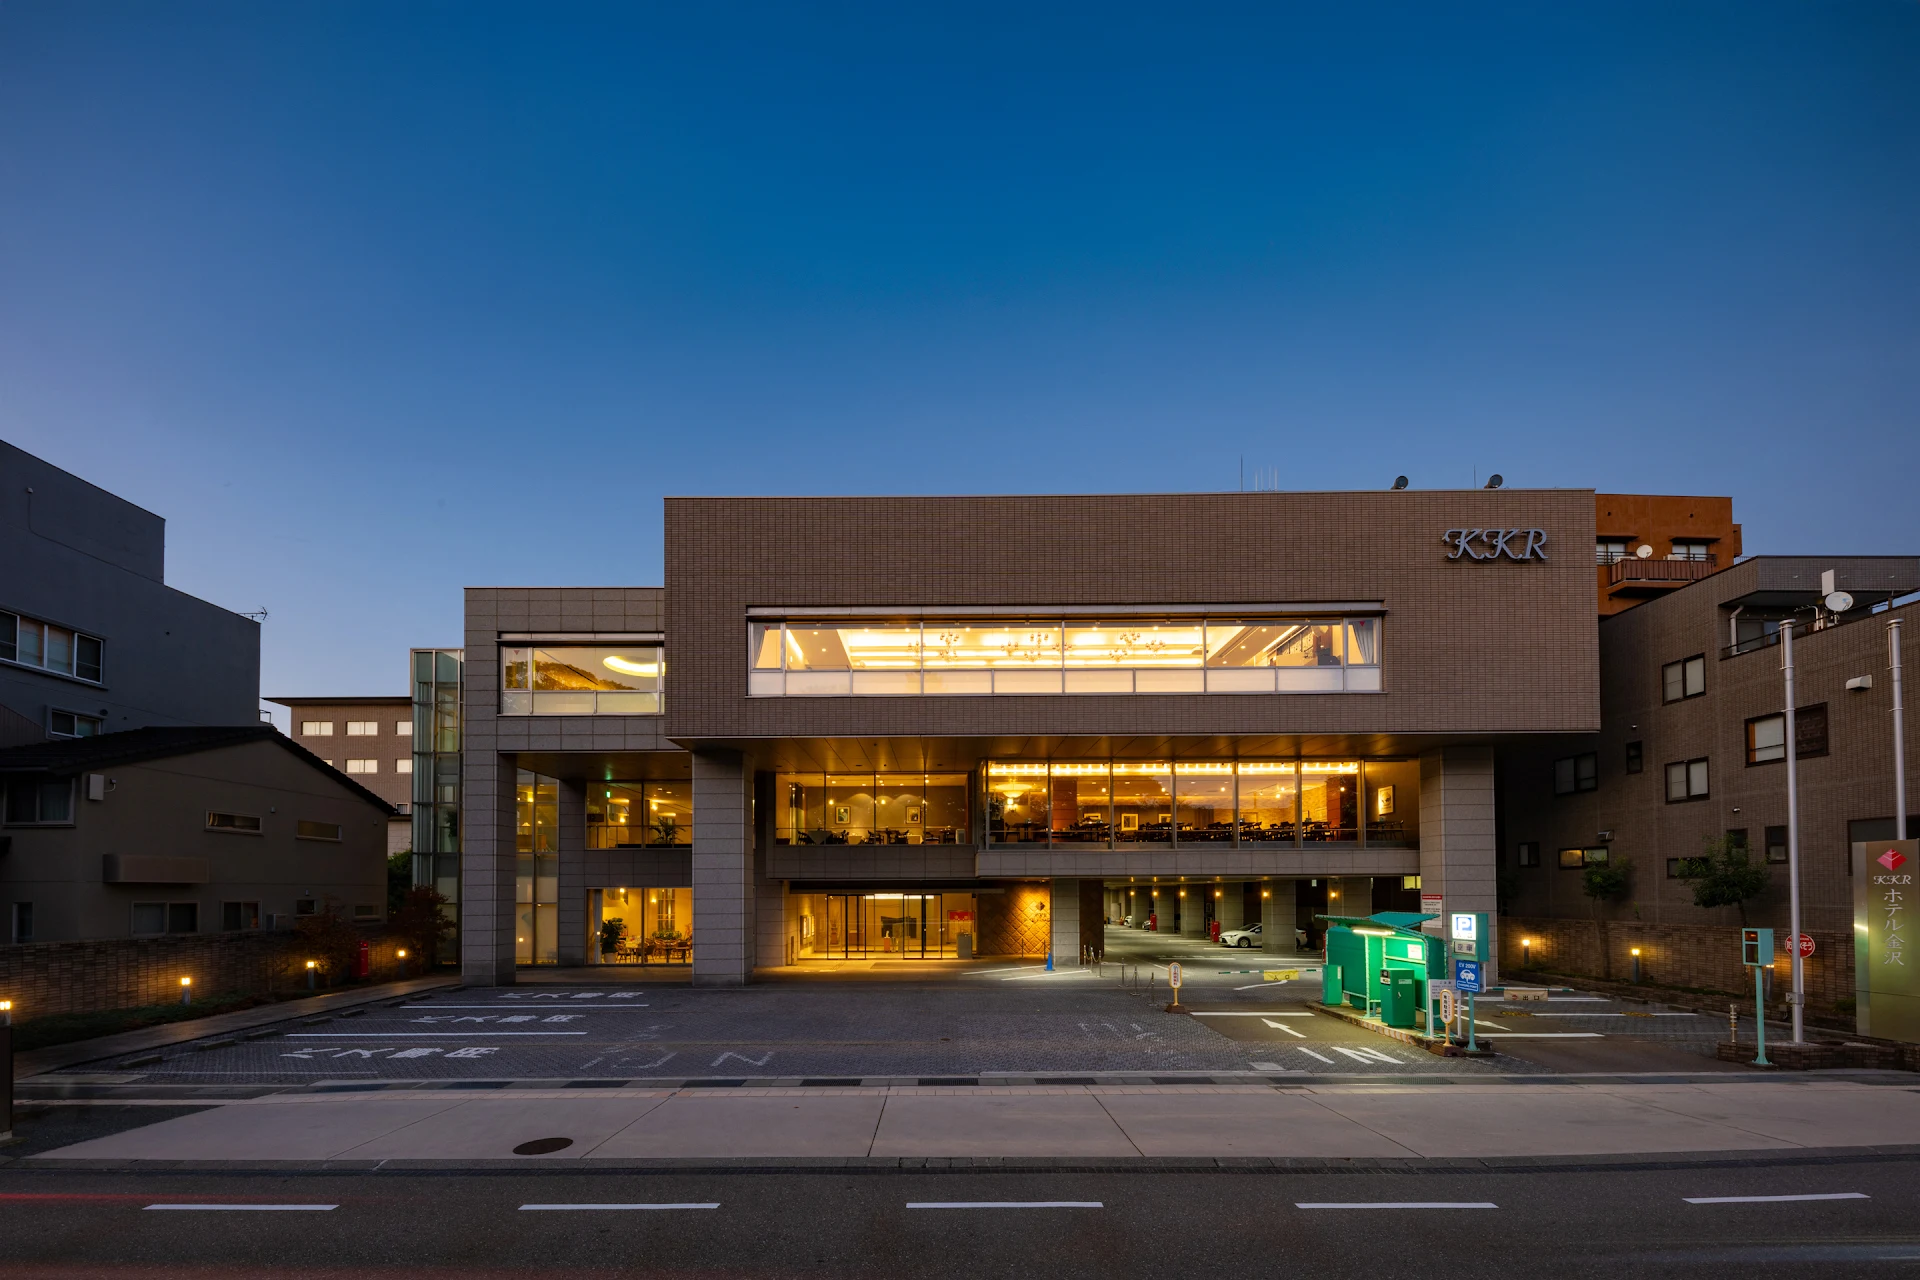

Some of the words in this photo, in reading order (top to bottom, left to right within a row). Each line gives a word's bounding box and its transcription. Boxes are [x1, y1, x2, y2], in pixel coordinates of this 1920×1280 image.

[1442, 528, 1548, 559] KKR
[1873, 874, 1912, 885] KKR
[1883, 888, 1905, 966] ホテル金沢
[1296, 1046, 1405, 1065] IN
